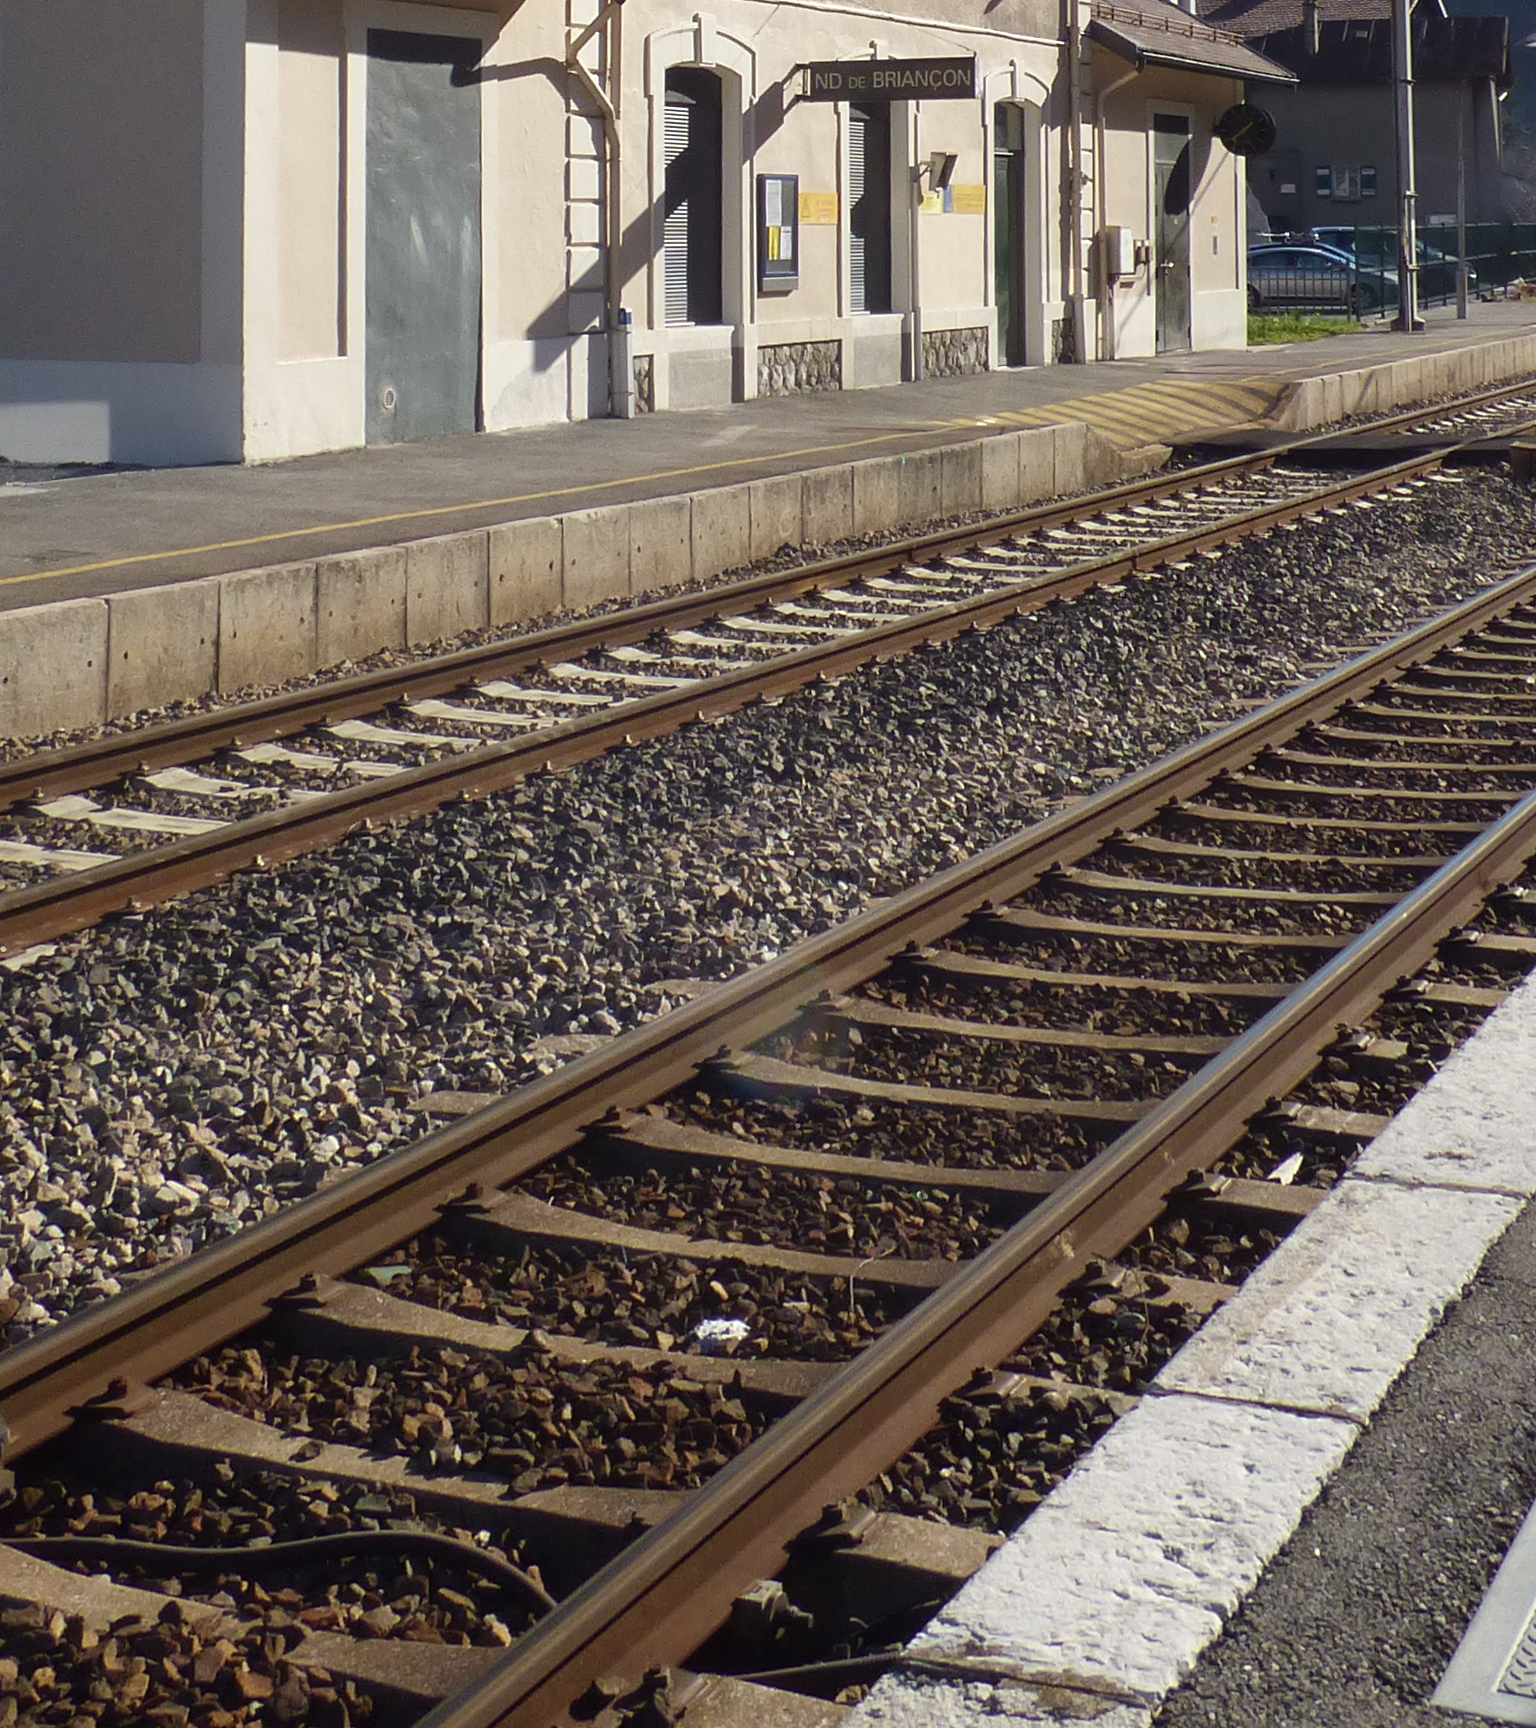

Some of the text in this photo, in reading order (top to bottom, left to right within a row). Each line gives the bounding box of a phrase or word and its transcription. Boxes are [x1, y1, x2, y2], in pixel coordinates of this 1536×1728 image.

[815, 69, 971, 91] ND DE BRIANÇON
